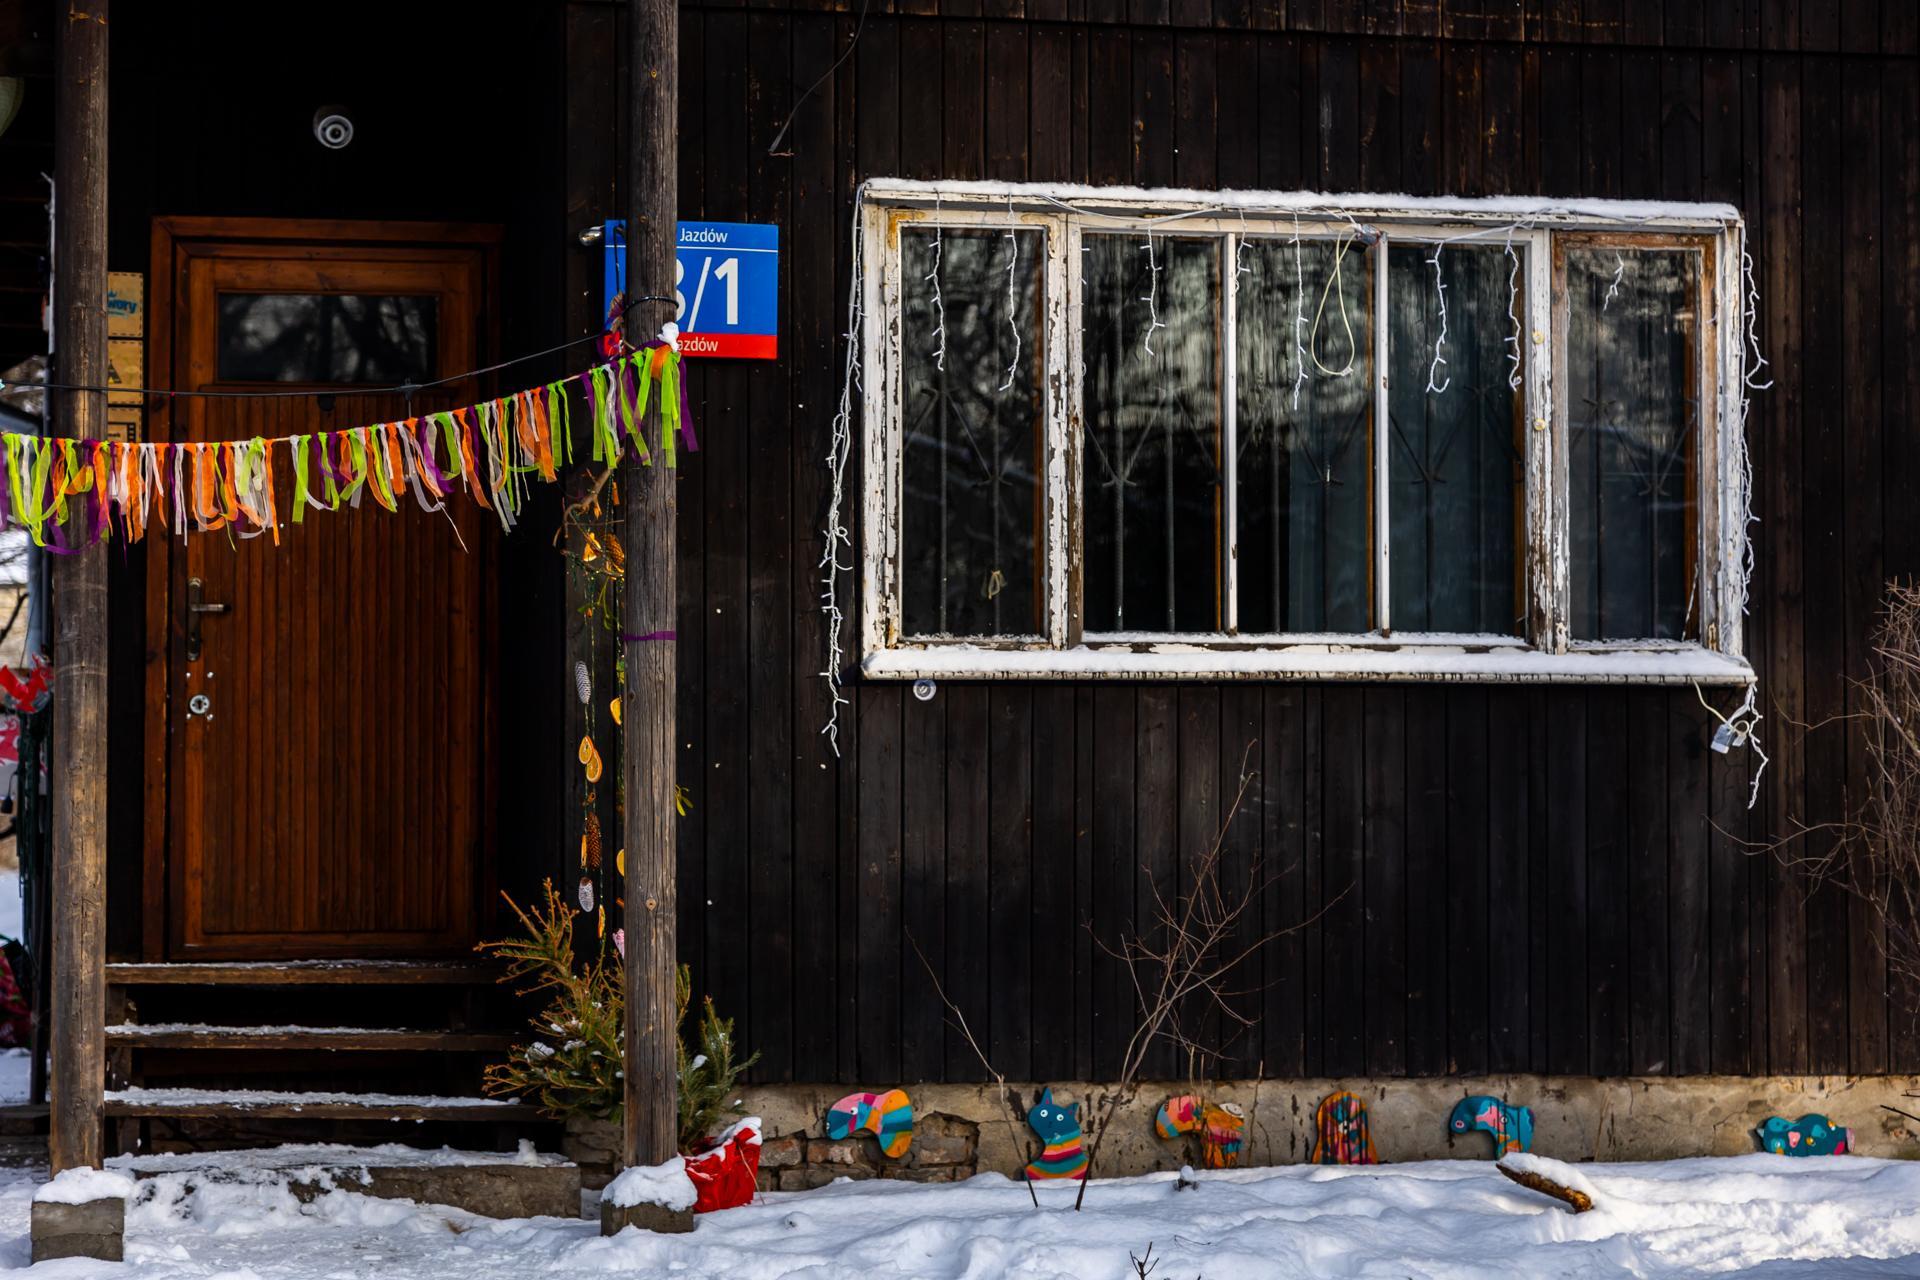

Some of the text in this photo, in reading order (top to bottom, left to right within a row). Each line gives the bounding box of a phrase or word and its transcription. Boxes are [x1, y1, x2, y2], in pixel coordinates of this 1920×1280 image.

[680, 227, 728, 243] Jazdów
[676, 256, 739, 333] /1
[677, 336, 719, 352] azdów
